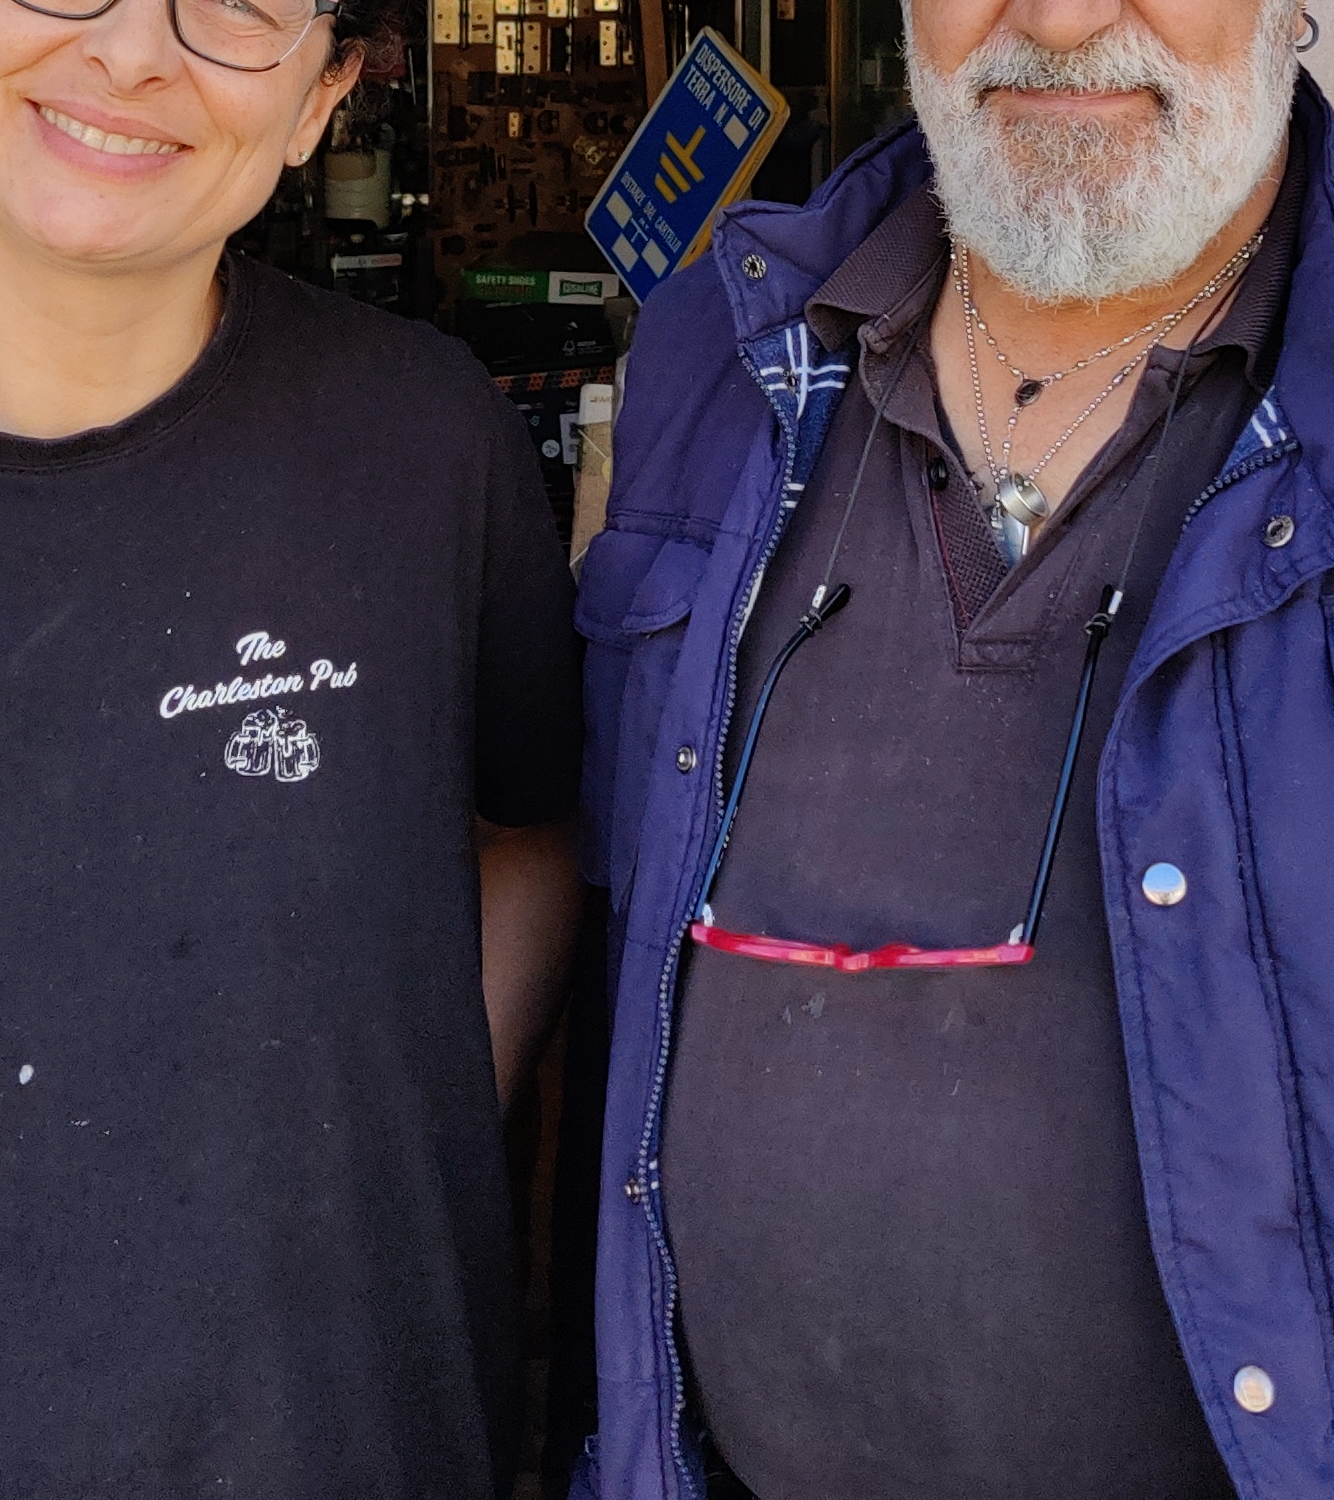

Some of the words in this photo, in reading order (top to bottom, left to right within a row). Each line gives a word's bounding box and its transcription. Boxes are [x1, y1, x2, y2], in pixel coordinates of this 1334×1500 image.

[682, 64, 716, 111] TERRA
[695, 42, 753, 114] DISPERSORE
[235, 631, 286, 666] The
[159, 673, 304, 719] Charleston
[309, 658, 358, 691] Pub
